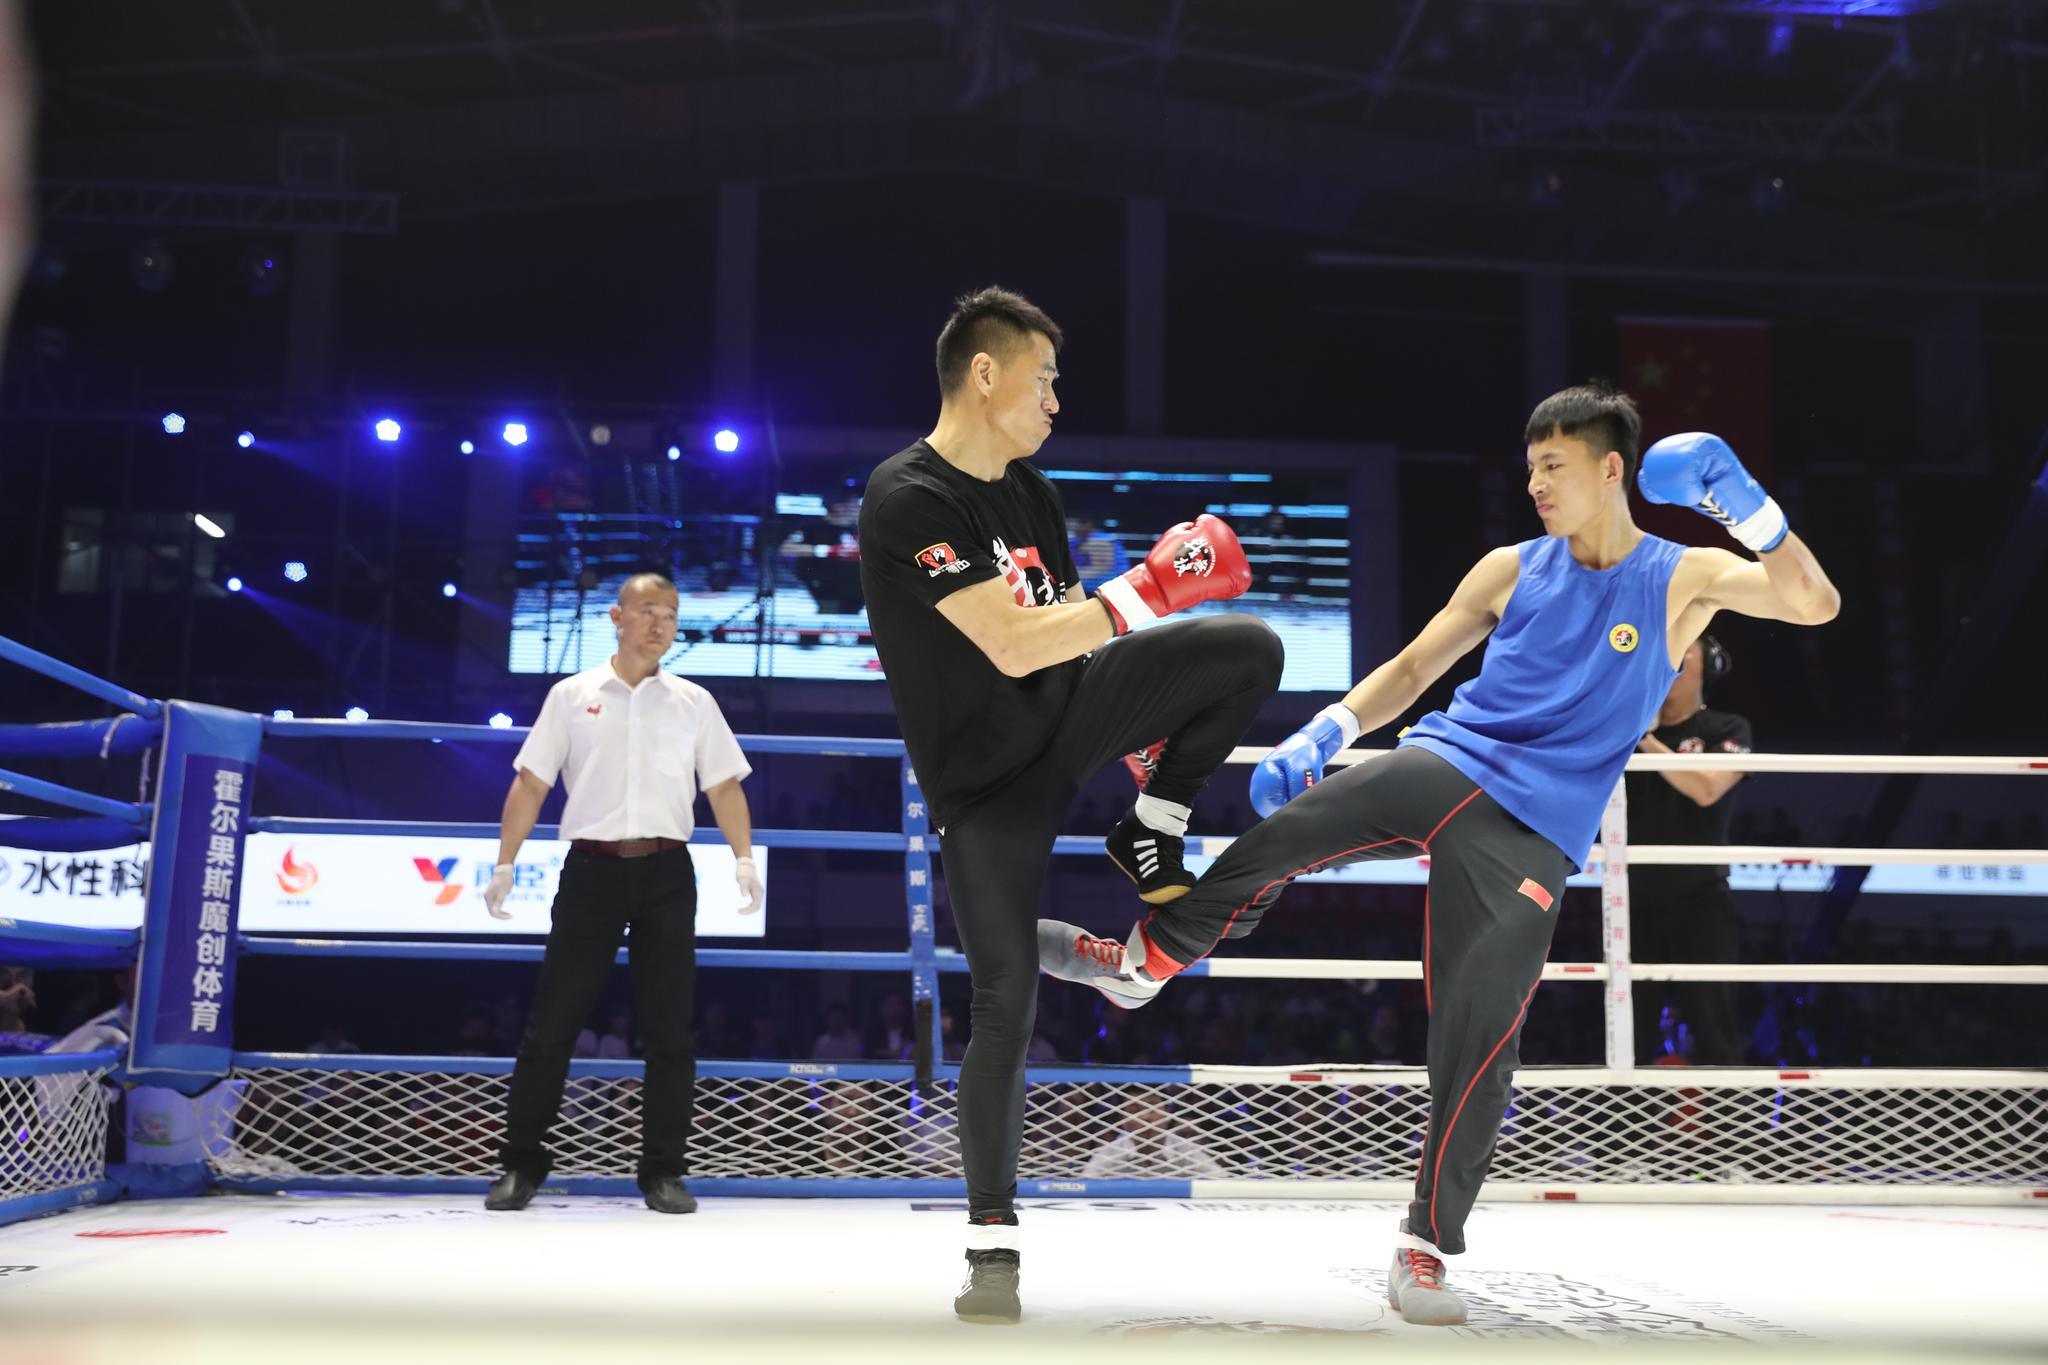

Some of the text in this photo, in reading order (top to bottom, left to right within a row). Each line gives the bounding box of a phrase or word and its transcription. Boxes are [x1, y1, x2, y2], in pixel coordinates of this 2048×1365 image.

[20, 855, 147, 897] 水性科
[190, 769, 243, 1033] 霍尔果斯魔创体育
